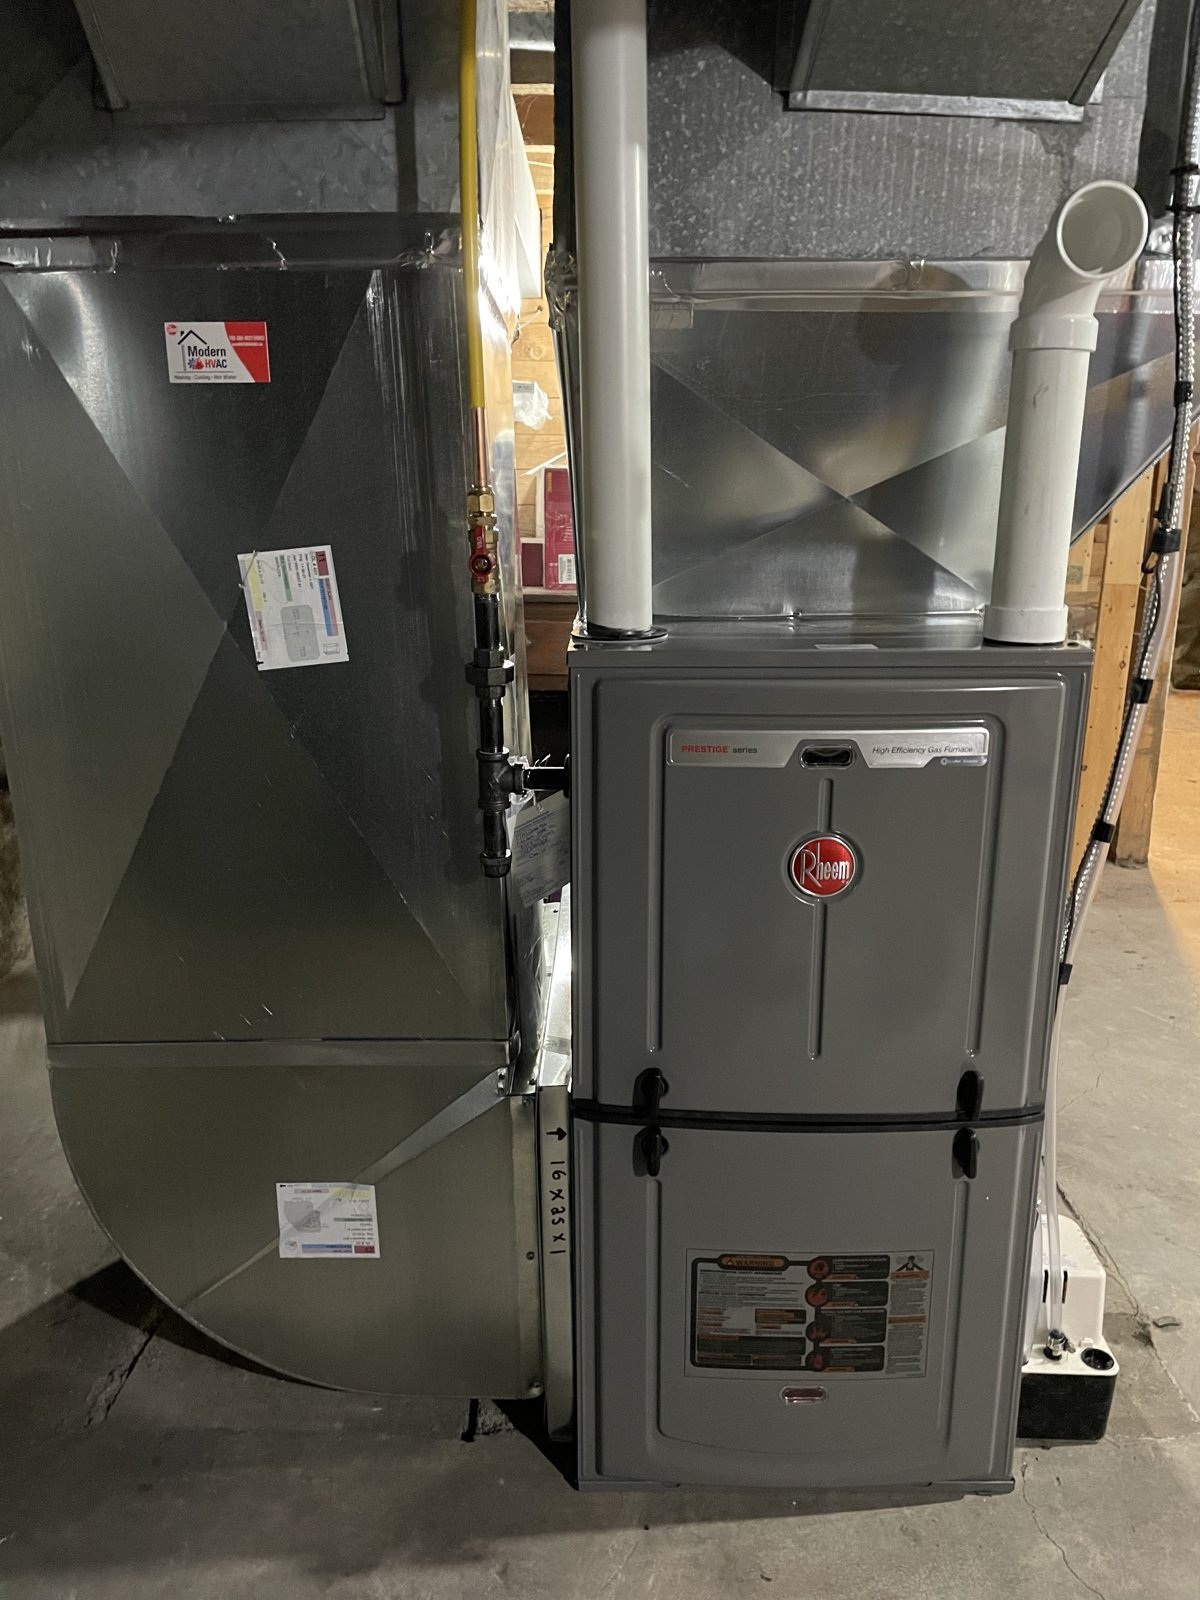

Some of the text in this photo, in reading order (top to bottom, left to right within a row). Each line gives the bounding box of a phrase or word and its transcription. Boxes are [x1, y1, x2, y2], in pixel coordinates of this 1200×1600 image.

[187, 345, 227, 357] Modern
[205, 359, 227, 369] HVAC
[681, 744, 758, 754] PRESTIGE series
[872, 746, 890, 755] High
[891, 746, 926, 754] Efficiency
[944, 745, 973, 753] Furnace
[799, 842, 850, 887] Rheem
